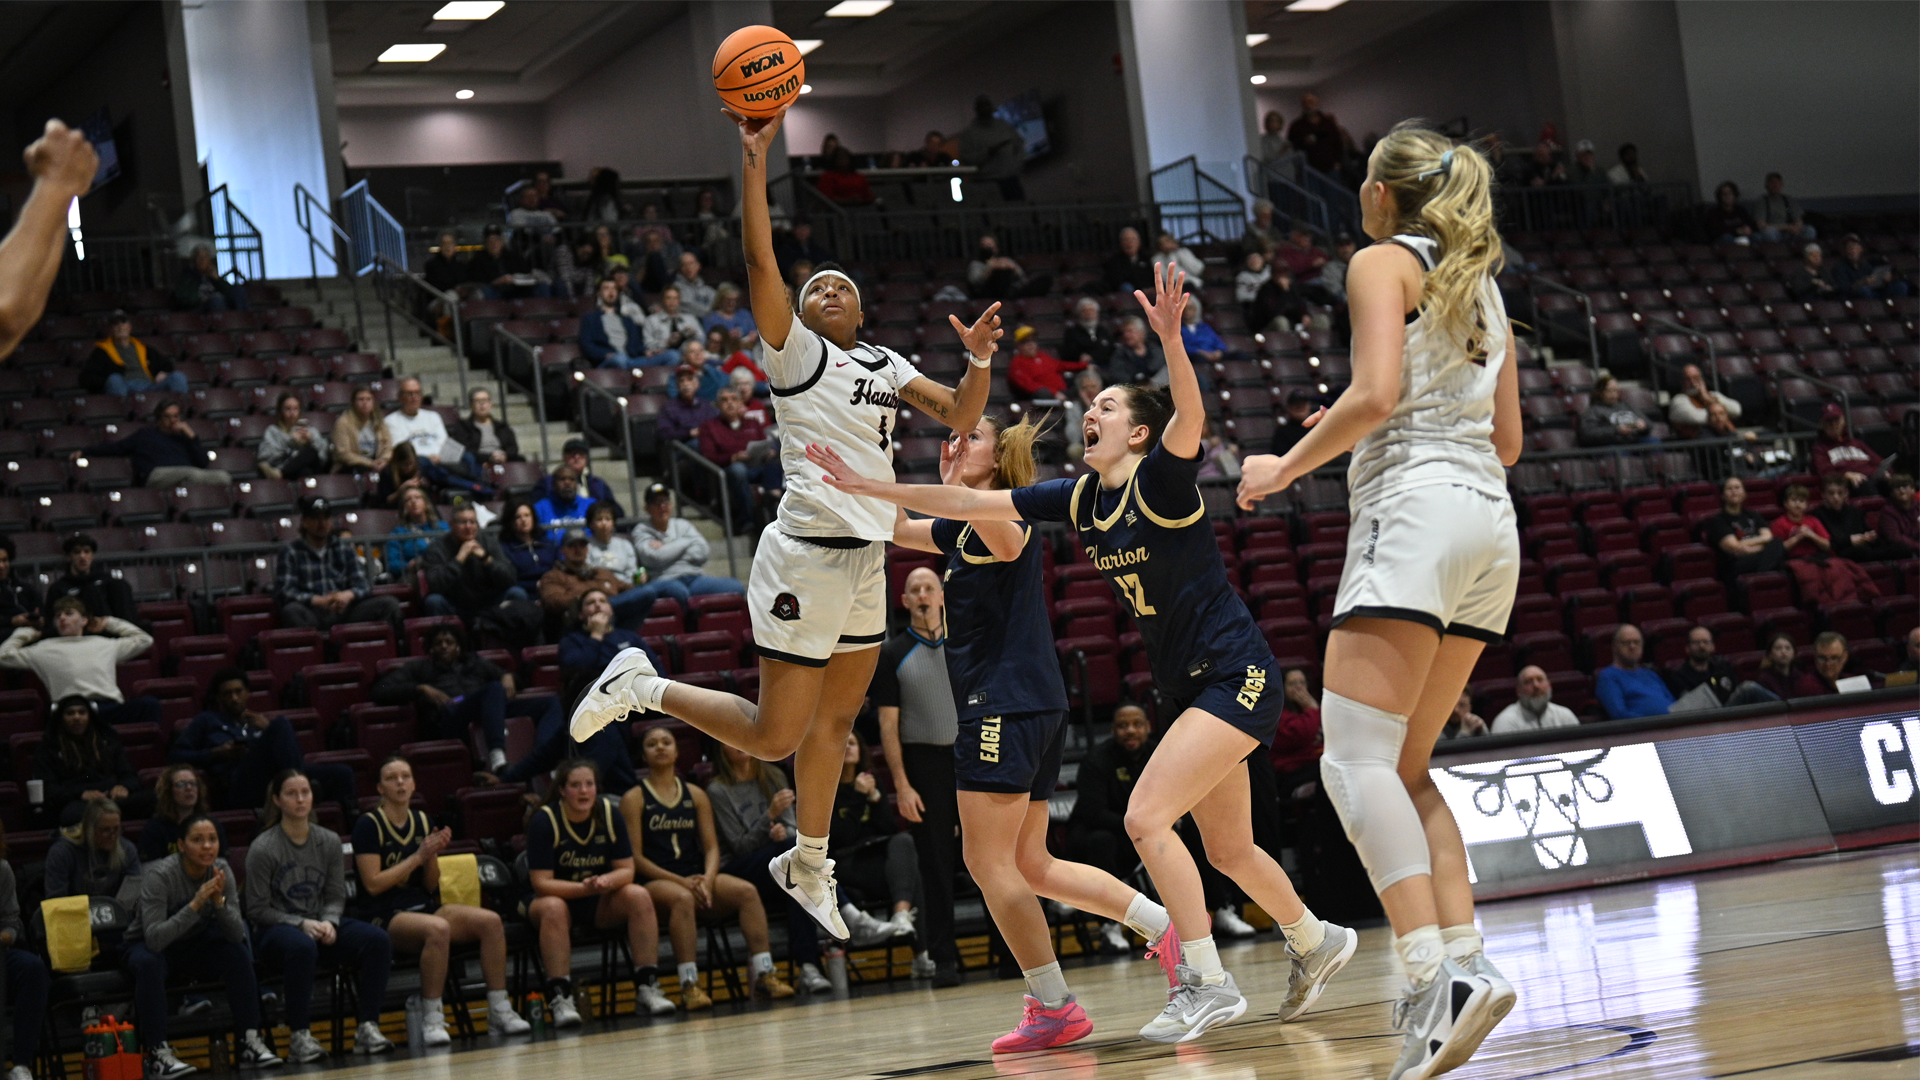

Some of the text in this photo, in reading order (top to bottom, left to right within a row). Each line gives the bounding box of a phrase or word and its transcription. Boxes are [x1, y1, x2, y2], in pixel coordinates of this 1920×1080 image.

[740, 51, 785, 78] NCAA
[743, 74, 800, 102] Wilson
[1113, 573, 1157, 618] 12
[1235, 664, 1266, 712] EAGLE
[648, 813, 695, 830] Clarion
[558, 850, 605, 867] Clarion
[670, 832, 681, 860] 1
